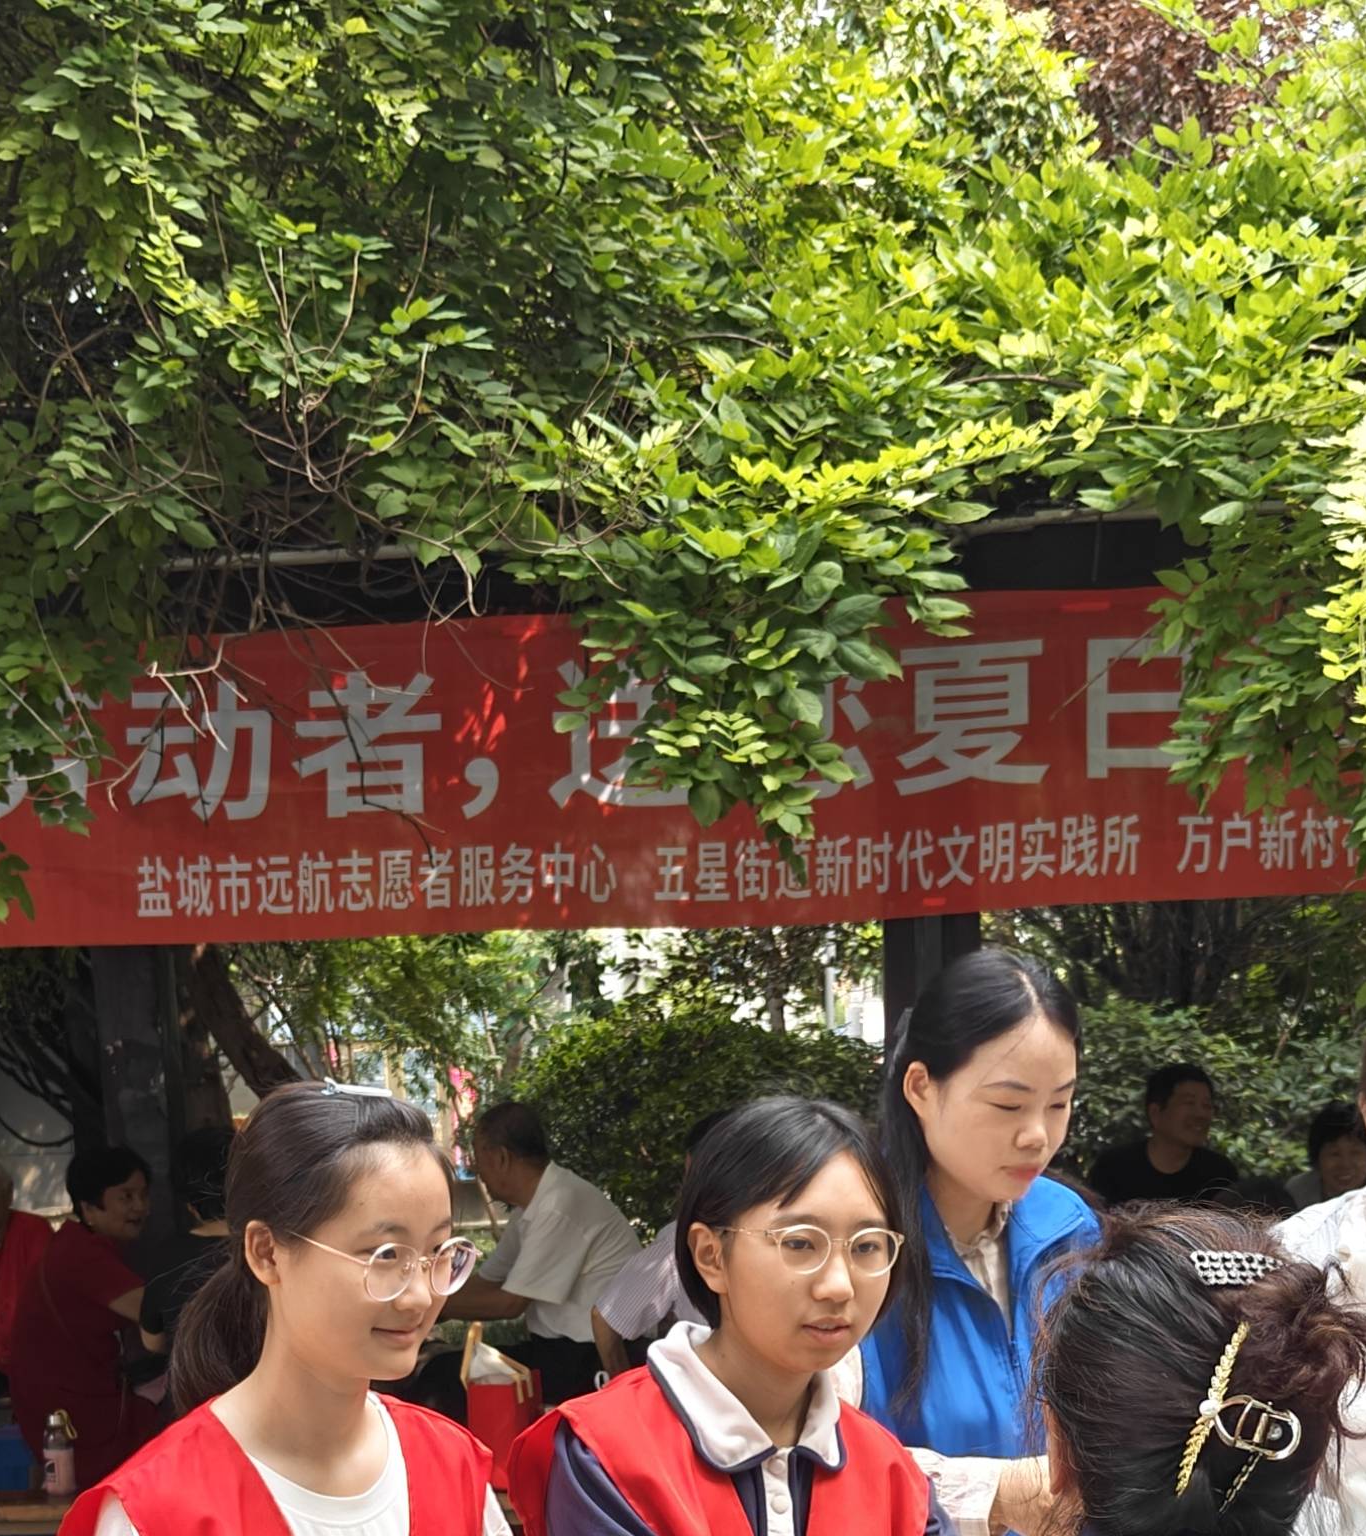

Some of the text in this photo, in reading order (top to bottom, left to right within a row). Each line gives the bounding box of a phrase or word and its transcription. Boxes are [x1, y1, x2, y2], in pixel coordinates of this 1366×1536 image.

[137, 842, 617, 918] 盐城市远航志愿者服务中心
[654, 813, 1141, 902] 五星街道新时代文明实践所
